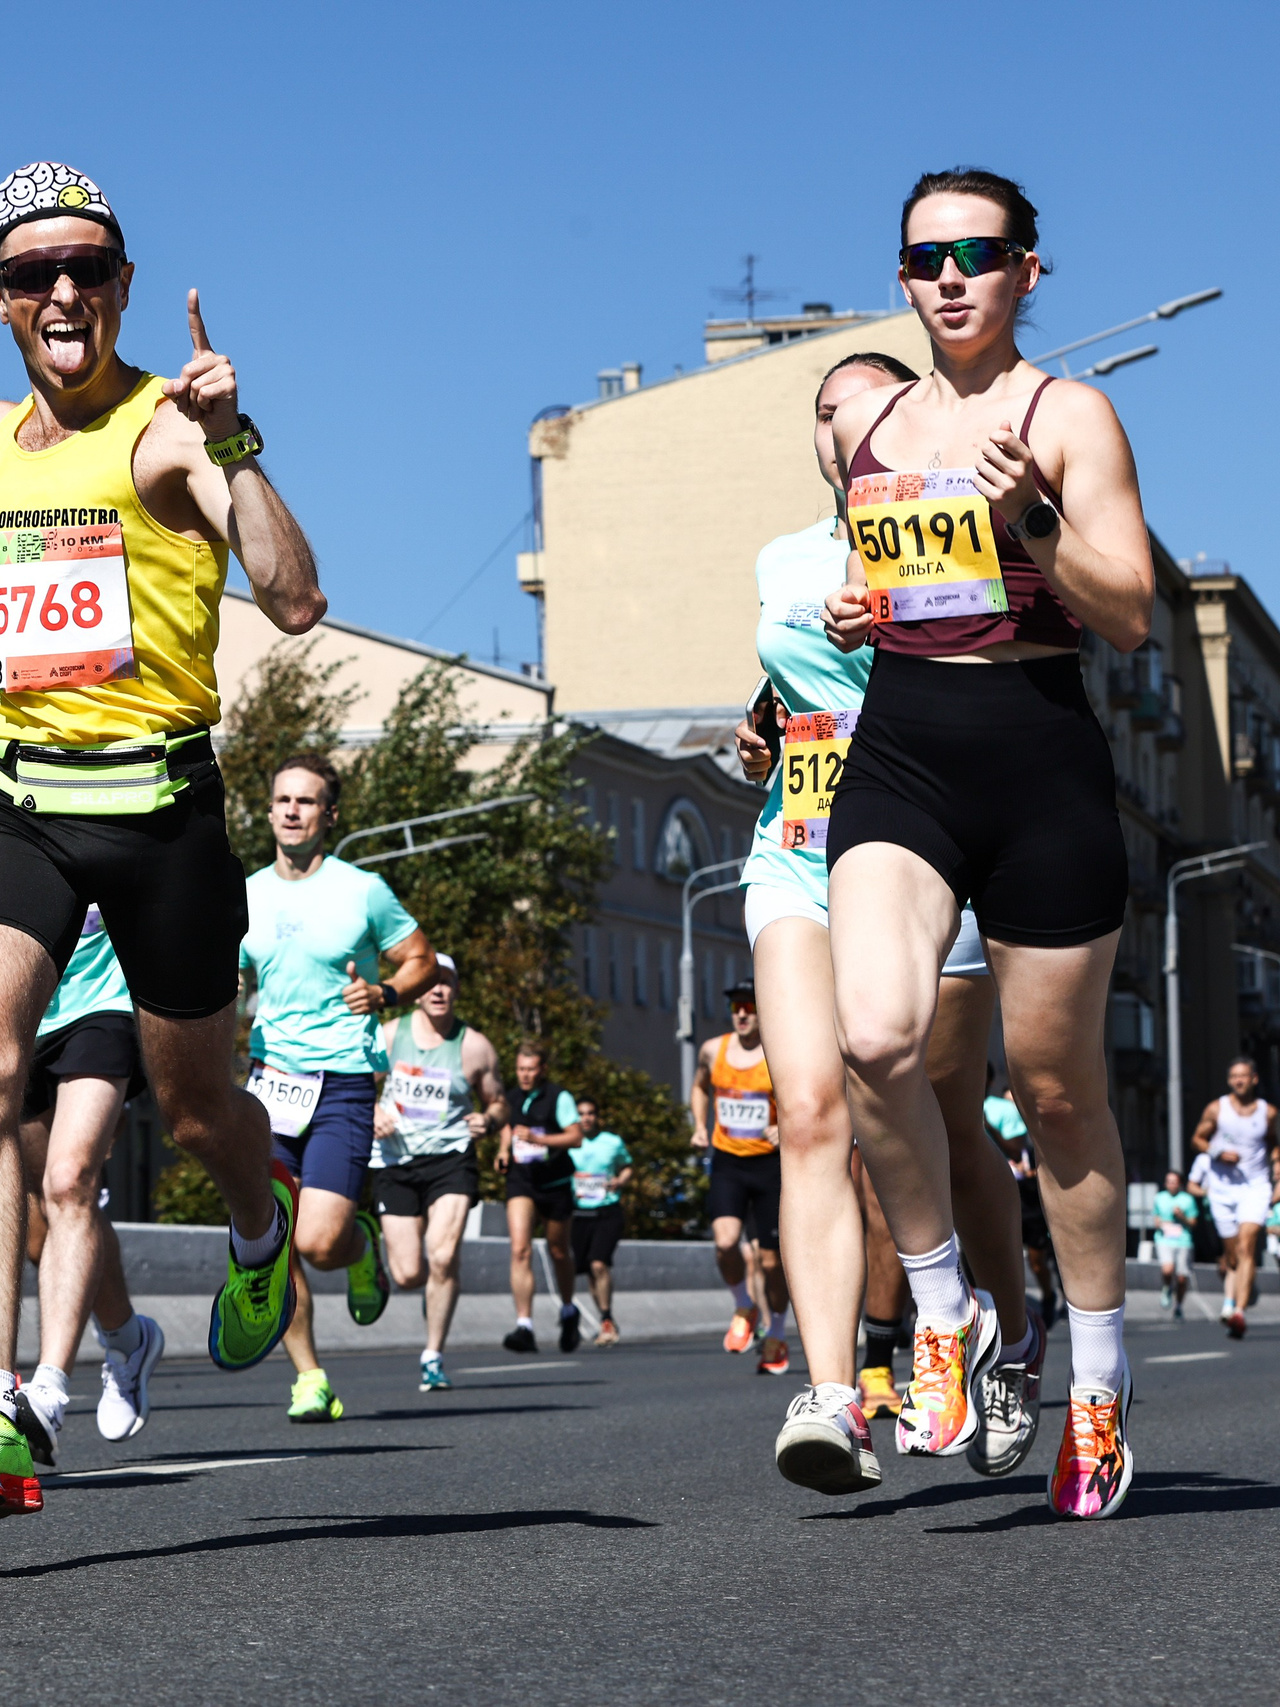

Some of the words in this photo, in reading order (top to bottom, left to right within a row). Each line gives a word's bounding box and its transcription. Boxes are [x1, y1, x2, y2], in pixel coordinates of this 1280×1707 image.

[61, 538, 76, 547] 10
[856, 510, 982, 563] 50191
[68, 544, 105, 553] 2026
[899, 561, 945, 577] ОЛЬГА
[880, 595, 889, 619] B
[70, 791, 152, 805] SILAPRO
[817, 797, 833, 811] ДА
[794, 825, 805, 846] B
[255, 1075, 314, 1108] 51500
[395, 1077, 445, 1100] 51696
[721, 1101, 766, 1120] 51772
